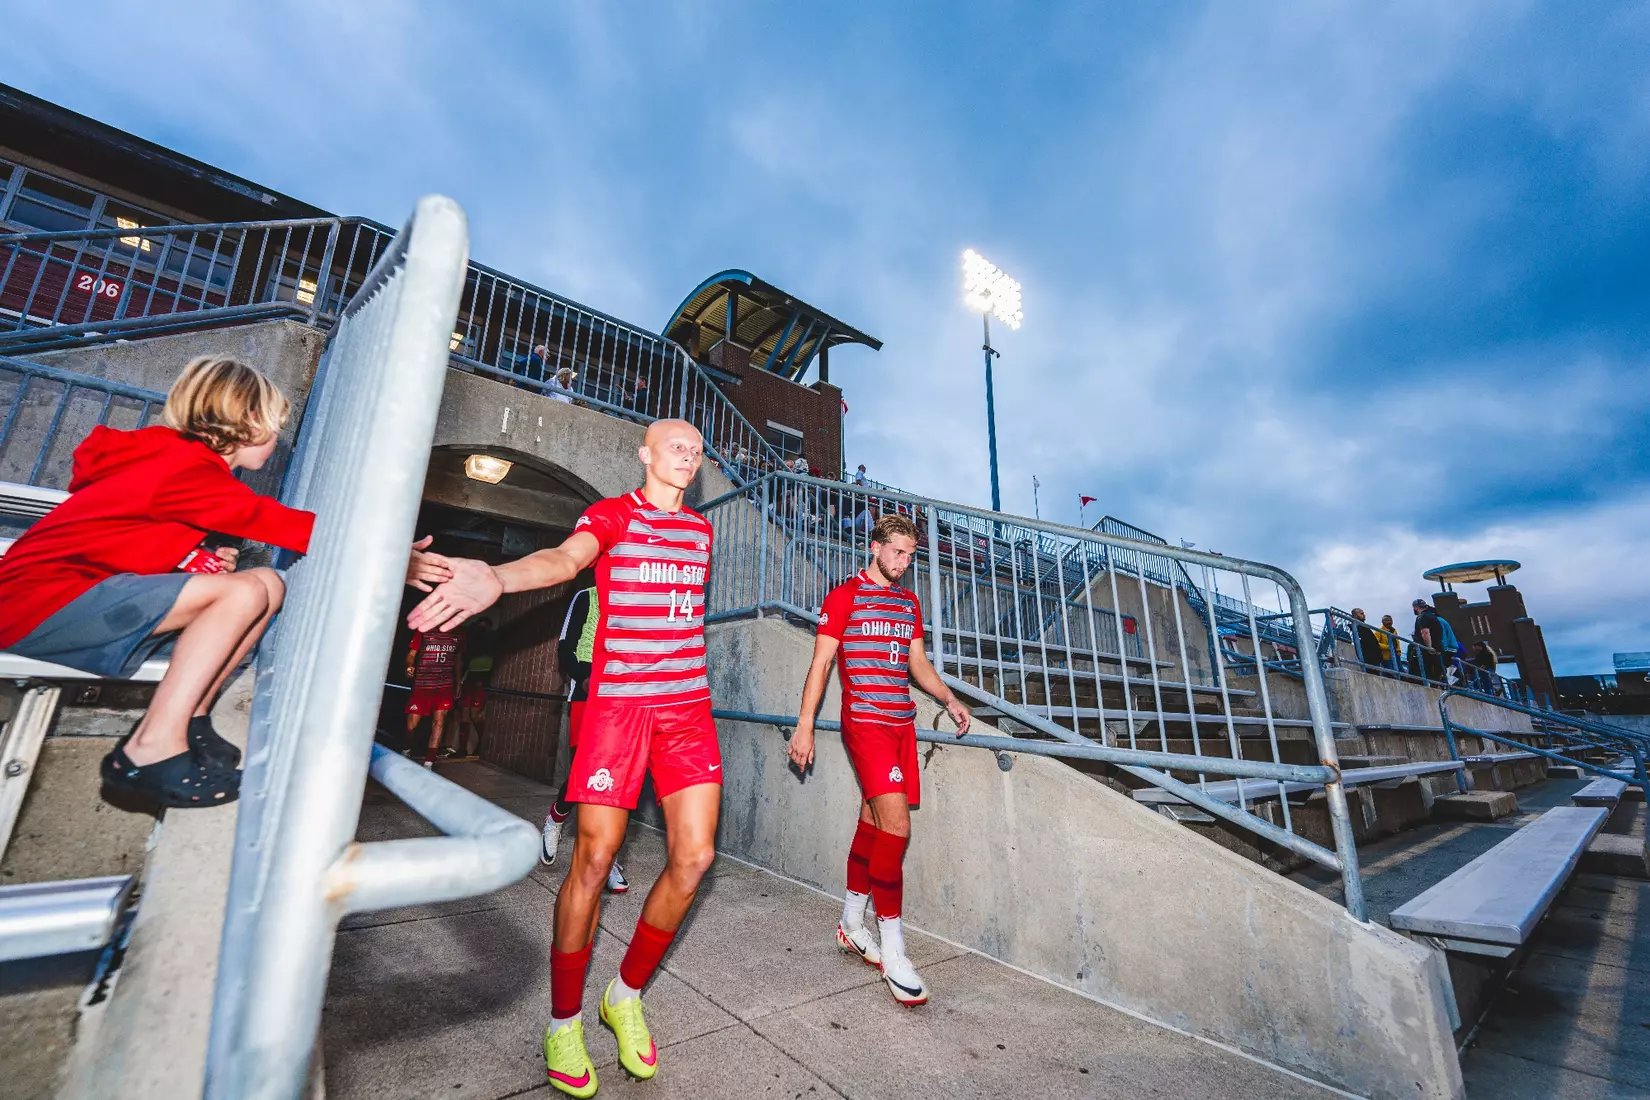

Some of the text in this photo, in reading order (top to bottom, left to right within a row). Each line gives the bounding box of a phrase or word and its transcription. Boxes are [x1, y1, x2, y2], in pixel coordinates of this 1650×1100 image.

[78, 275, 120, 298] 206
[639, 561, 678, 584] OHIO
[666, 589, 693, 622] 14
[861, 620, 891, 637] OHIO
[425, 644, 441, 652] OHIO
[435, 652, 447, 663] 15
[889, 640, 899, 665] 8
